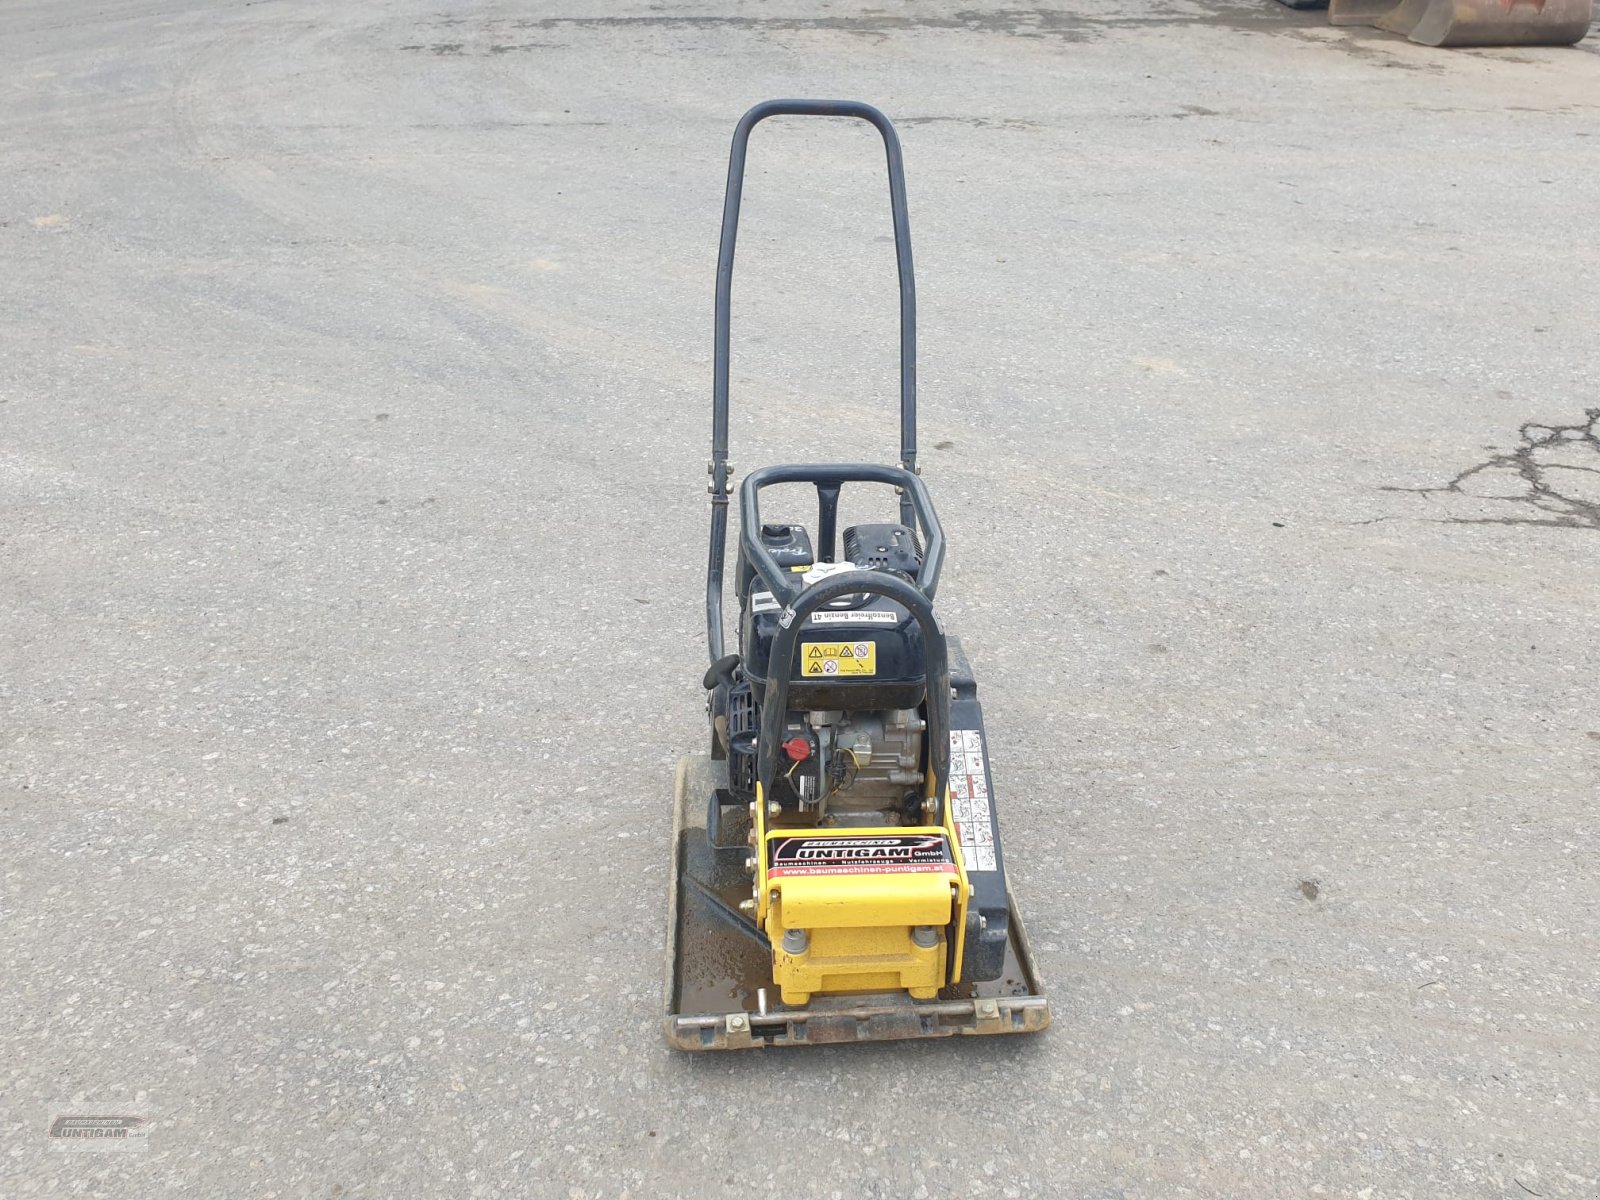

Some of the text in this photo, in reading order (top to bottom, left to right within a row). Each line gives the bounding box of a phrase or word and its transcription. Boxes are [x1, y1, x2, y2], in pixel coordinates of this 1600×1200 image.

[824, 612, 849, 620] Benzin
[805, 839, 897, 847] BAUMASCHINEN
[913, 849, 944, 857] GmbH
[782, 864, 945, 875] www.baumaschinen-puntigam.at
